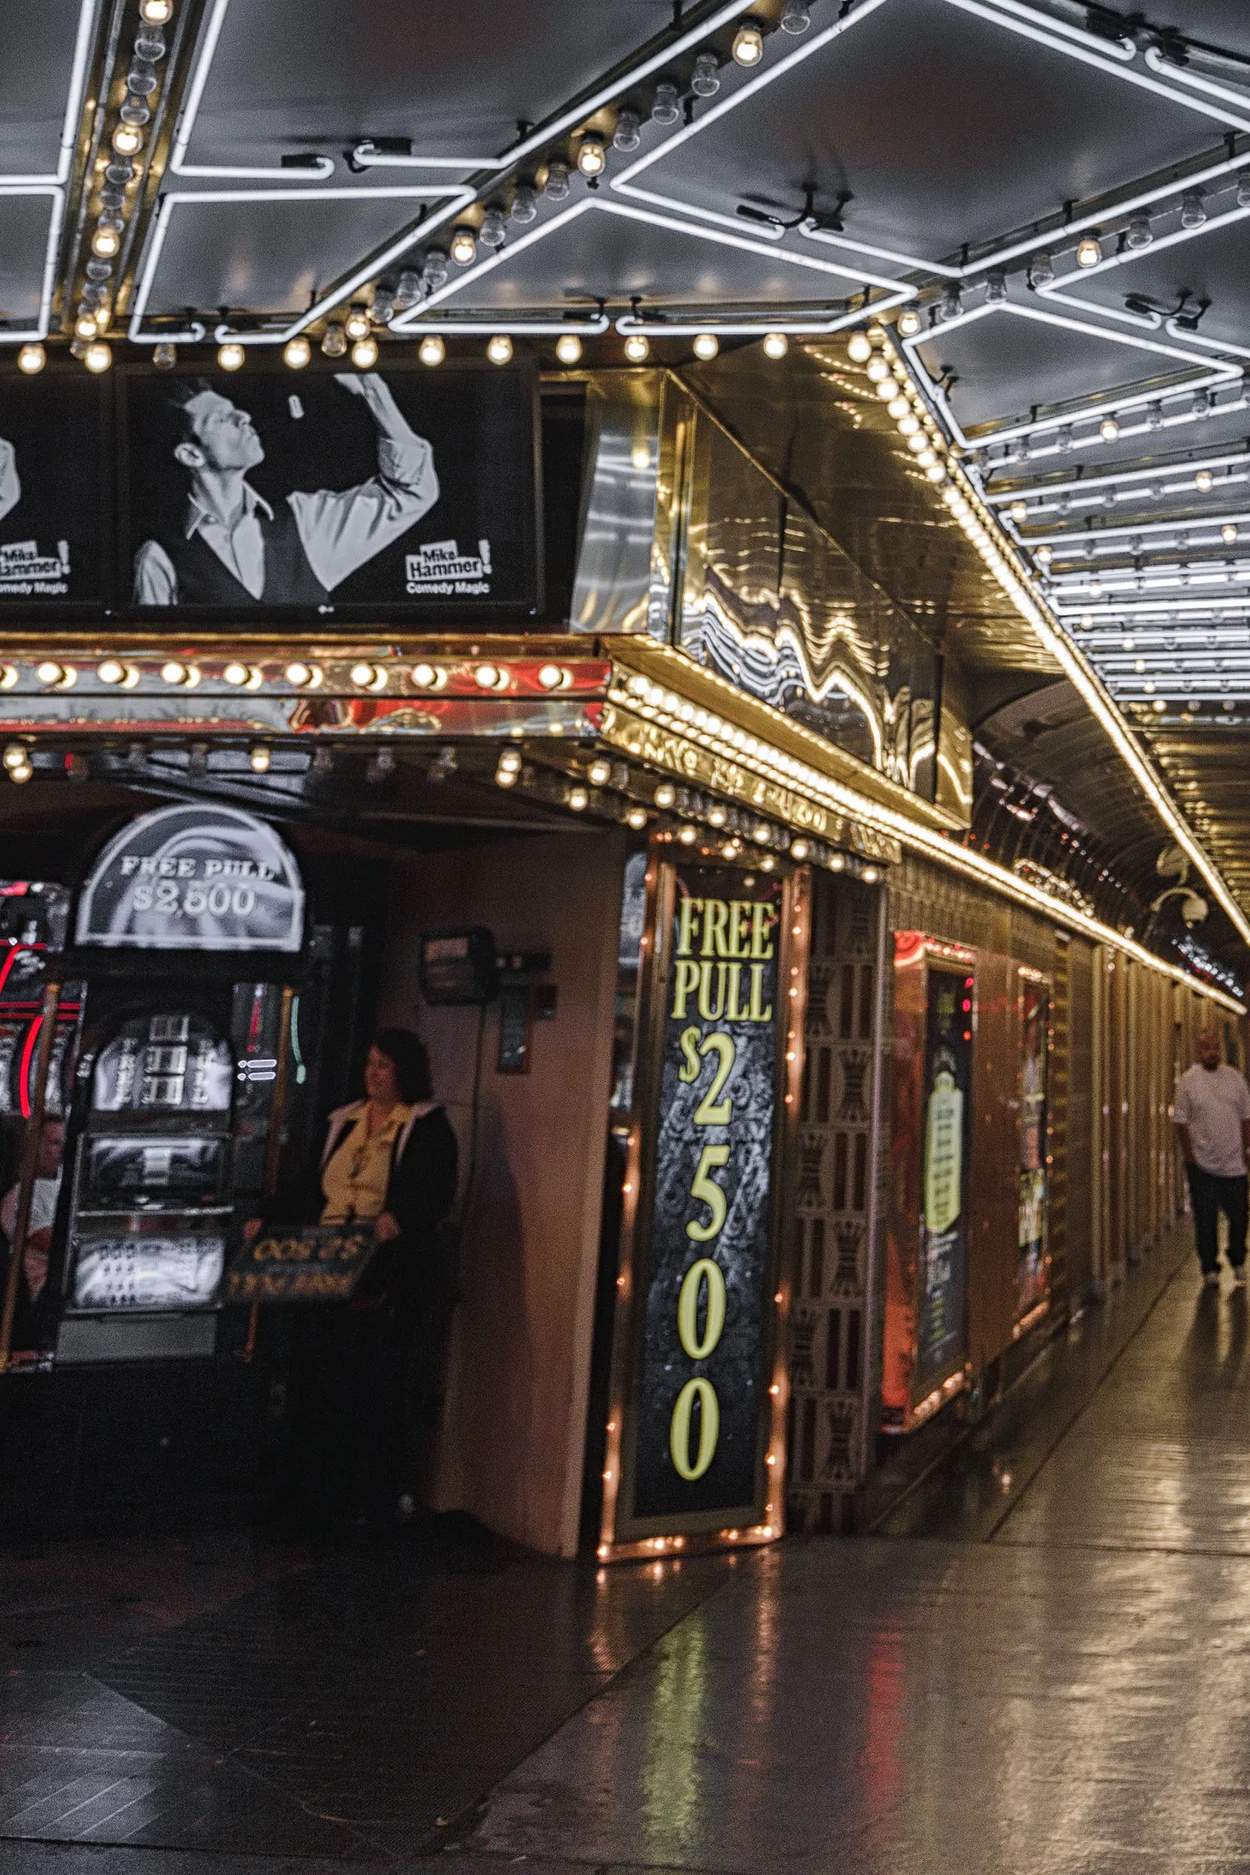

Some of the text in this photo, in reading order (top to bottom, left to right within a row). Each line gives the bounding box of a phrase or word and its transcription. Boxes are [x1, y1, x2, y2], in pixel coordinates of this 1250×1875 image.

[423, 549, 456, 563] Mike
[406, 582, 490, 595] Comedy Magic
[120, 855, 275, 881] FREE PULL
[132, 880, 255, 917] $2,500
[676, 897, 774, 960] FREE
[670, 960, 773, 1022] PULL
